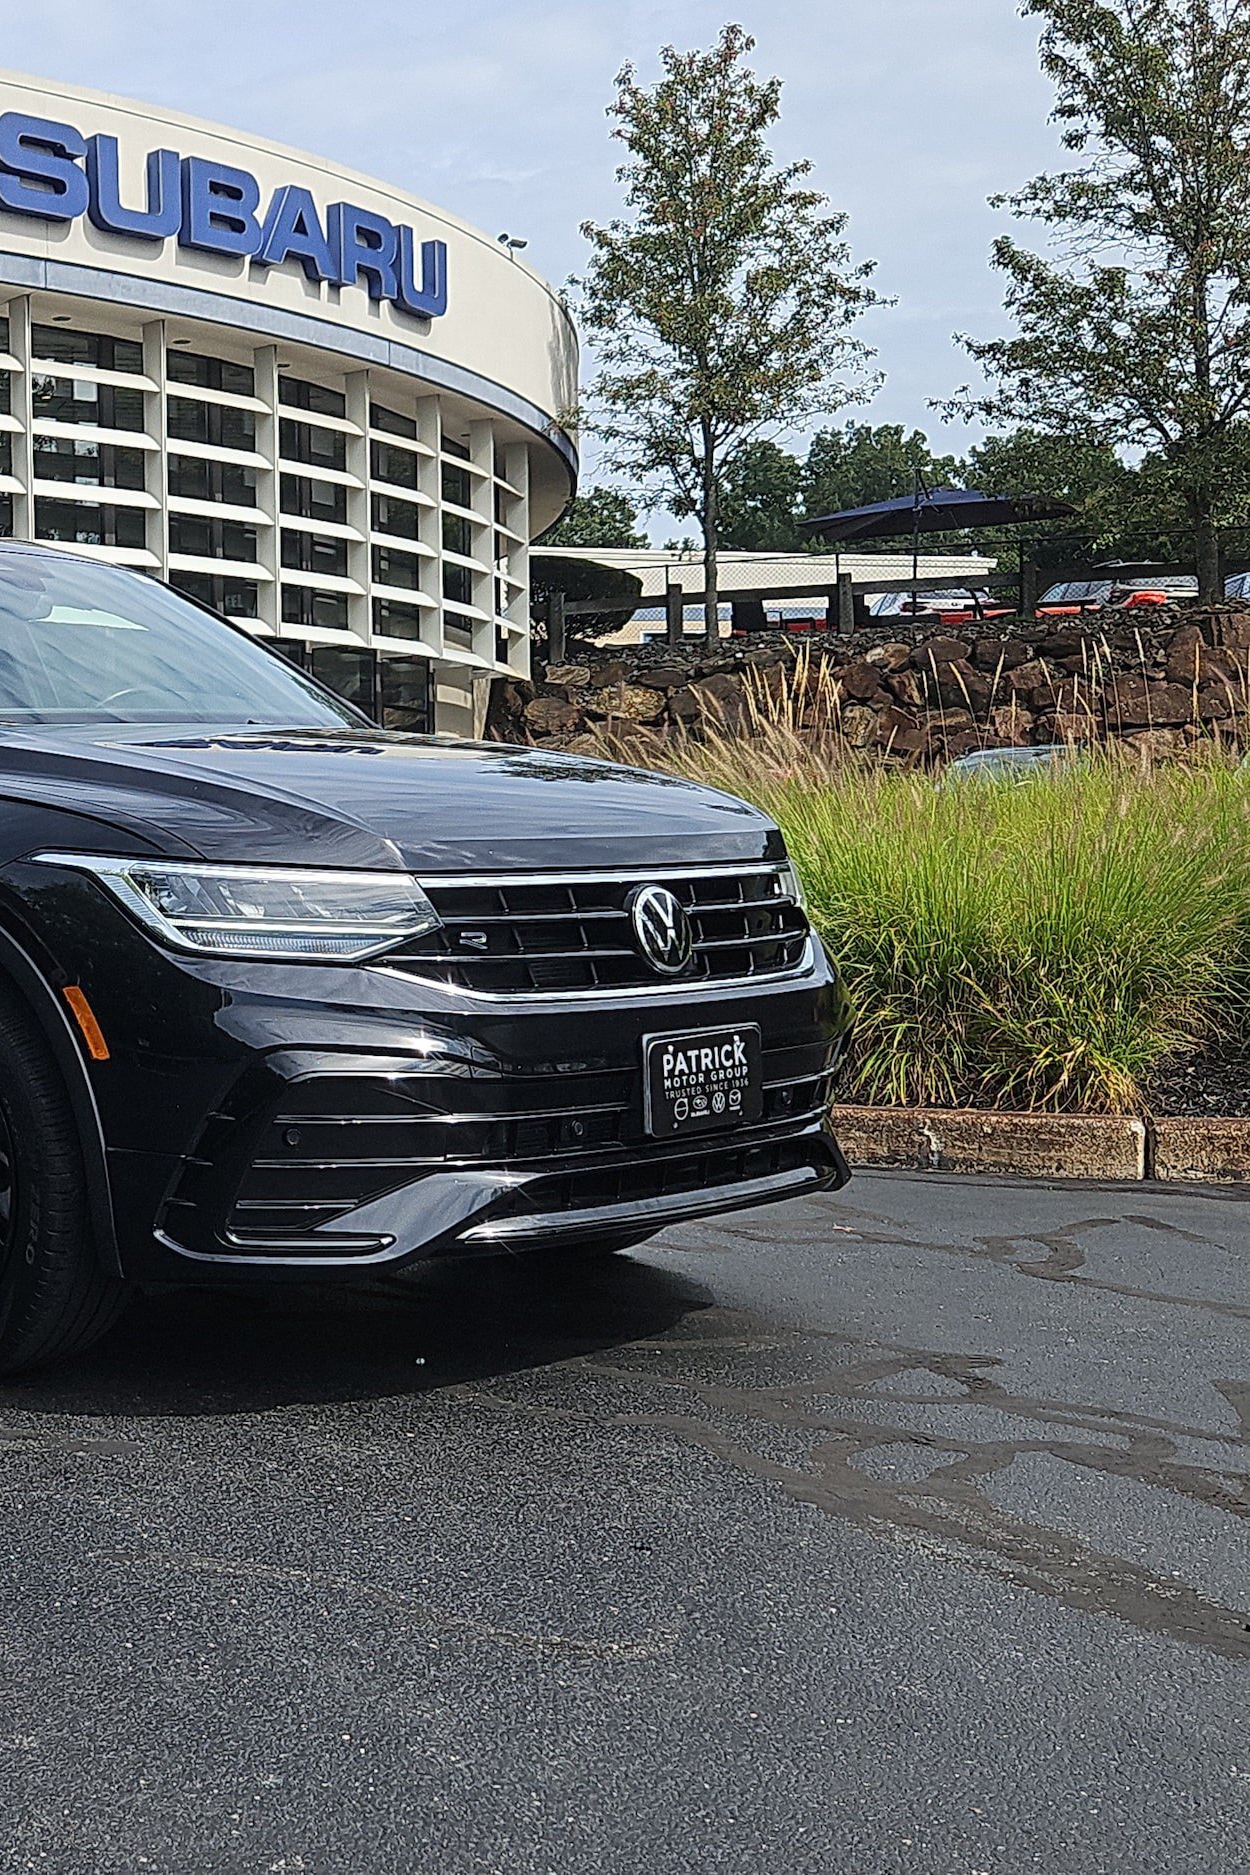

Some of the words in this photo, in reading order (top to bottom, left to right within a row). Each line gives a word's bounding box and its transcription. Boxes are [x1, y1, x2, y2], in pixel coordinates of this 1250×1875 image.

[662, 1042, 748, 1077] PATRICK
[664, 1073, 705, 1090] MOTOR
[710, 1066, 748, 1081] GROUP
[665, 1087, 702, 1100] TRUSTED
[705, 1081, 729, 1093] SINCE
